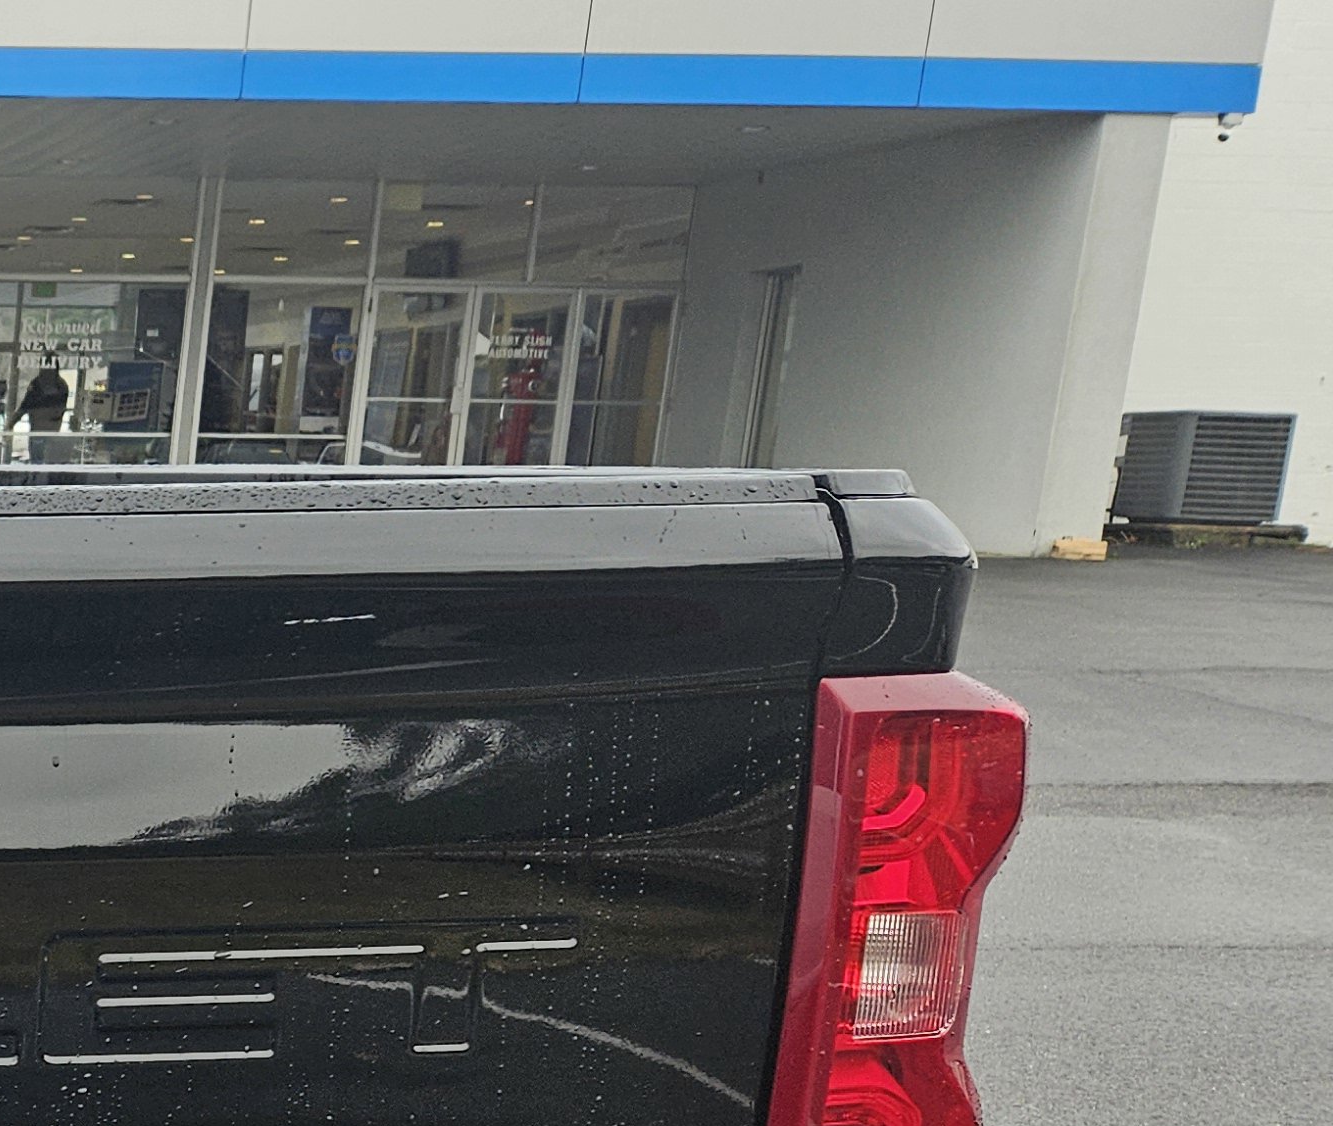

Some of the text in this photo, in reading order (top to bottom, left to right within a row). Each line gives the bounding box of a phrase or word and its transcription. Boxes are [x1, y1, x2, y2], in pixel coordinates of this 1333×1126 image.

[21, 317, 102, 334] Reserved
[20, 338, 102, 351] NEW CAR
[17, 355, 102, 369] DELIVERY
